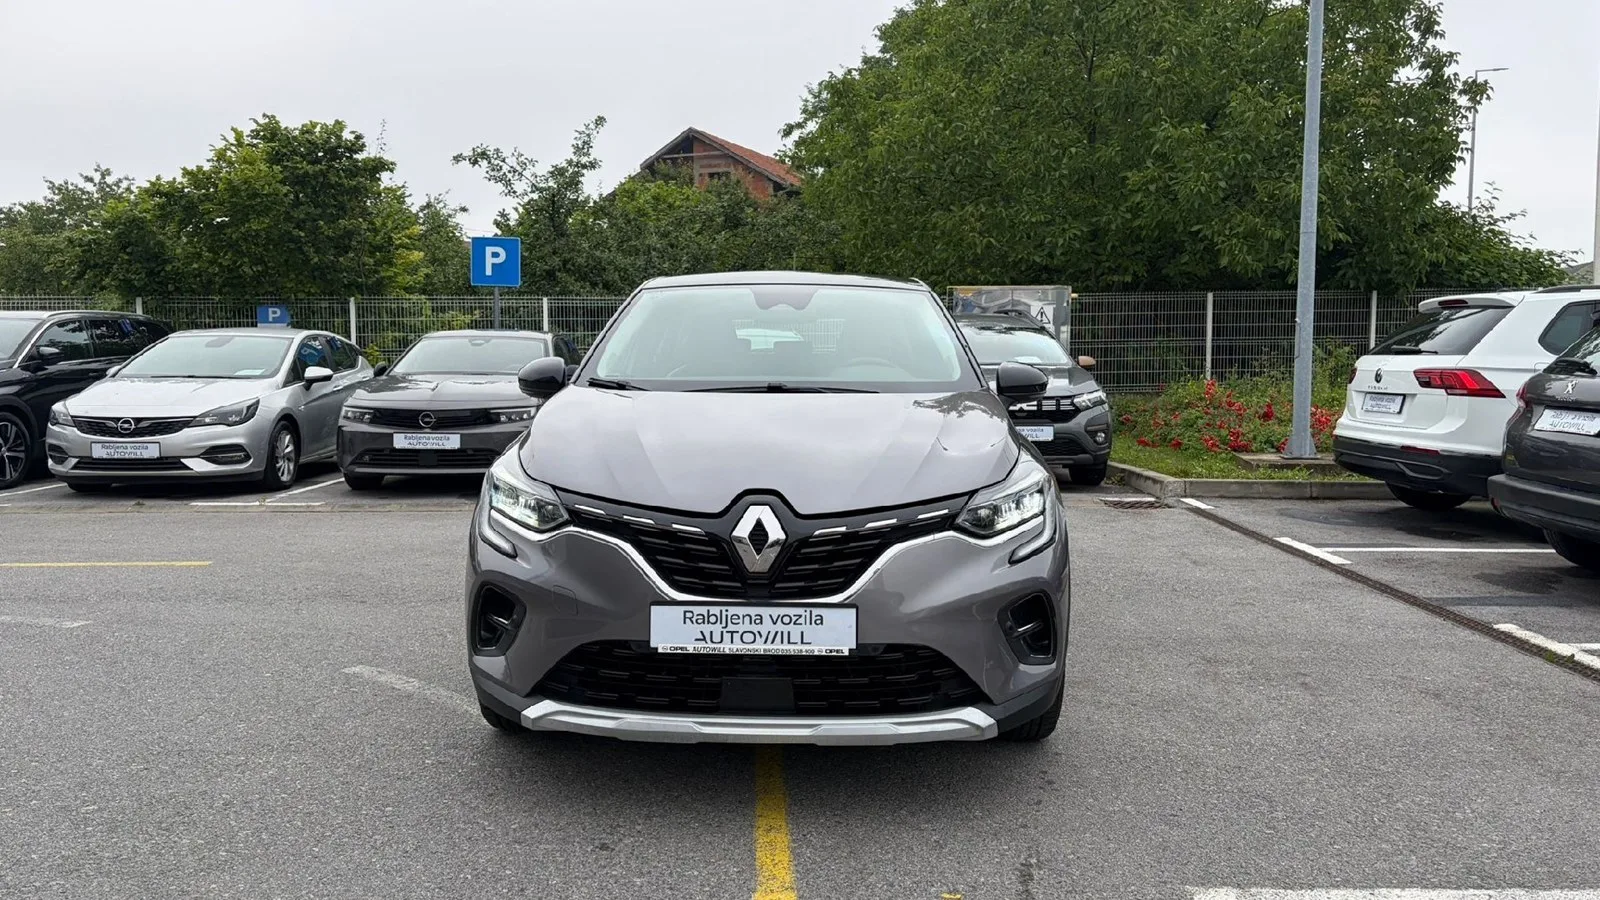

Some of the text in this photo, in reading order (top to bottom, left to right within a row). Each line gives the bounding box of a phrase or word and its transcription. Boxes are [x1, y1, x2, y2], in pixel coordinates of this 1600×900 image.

[485, 246, 506, 276] P
[268, 307, 281, 322] P
[683, 610, 824, 629] Rabljena vozila
[694, 630, 812, 645] AUTOWILL
